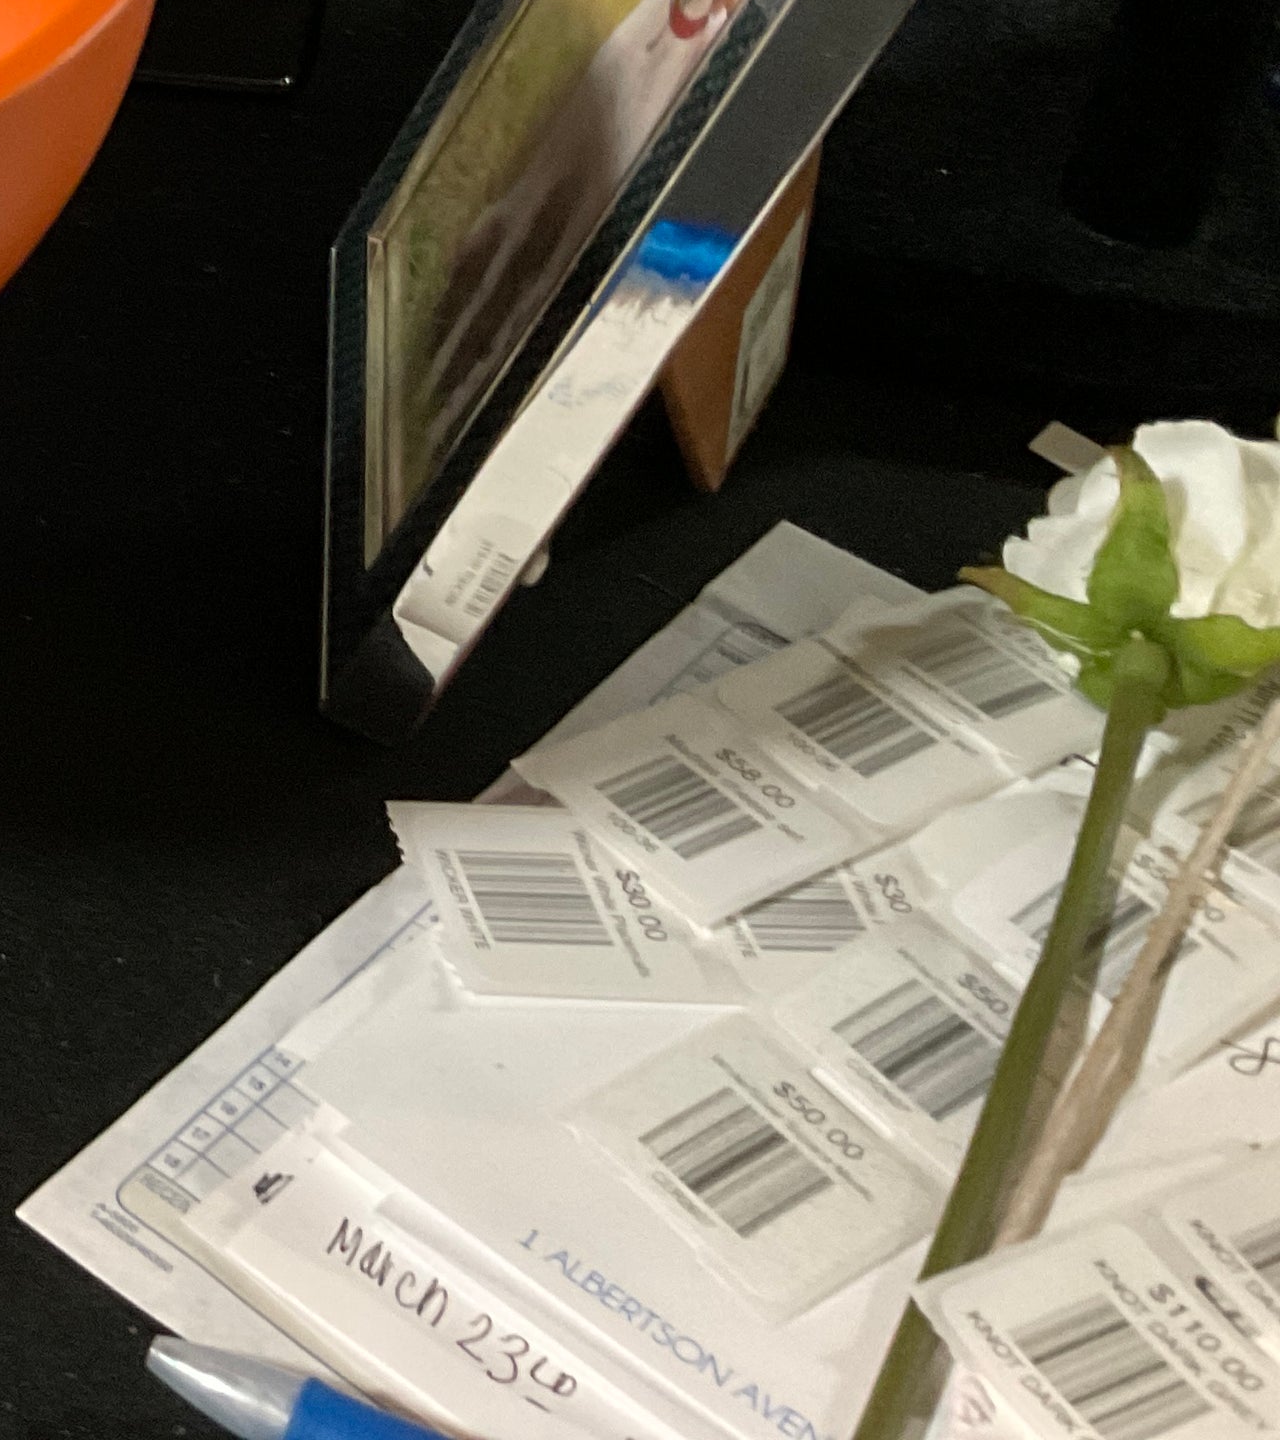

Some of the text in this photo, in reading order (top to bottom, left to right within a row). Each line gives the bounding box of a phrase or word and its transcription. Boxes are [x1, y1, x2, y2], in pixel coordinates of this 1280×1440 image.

[772, 1079, 866, 1162] $50.00
[547, 1248, 734, 1388] ALBERTSON
[1148, 1282, 1264, 1393] $110.00
